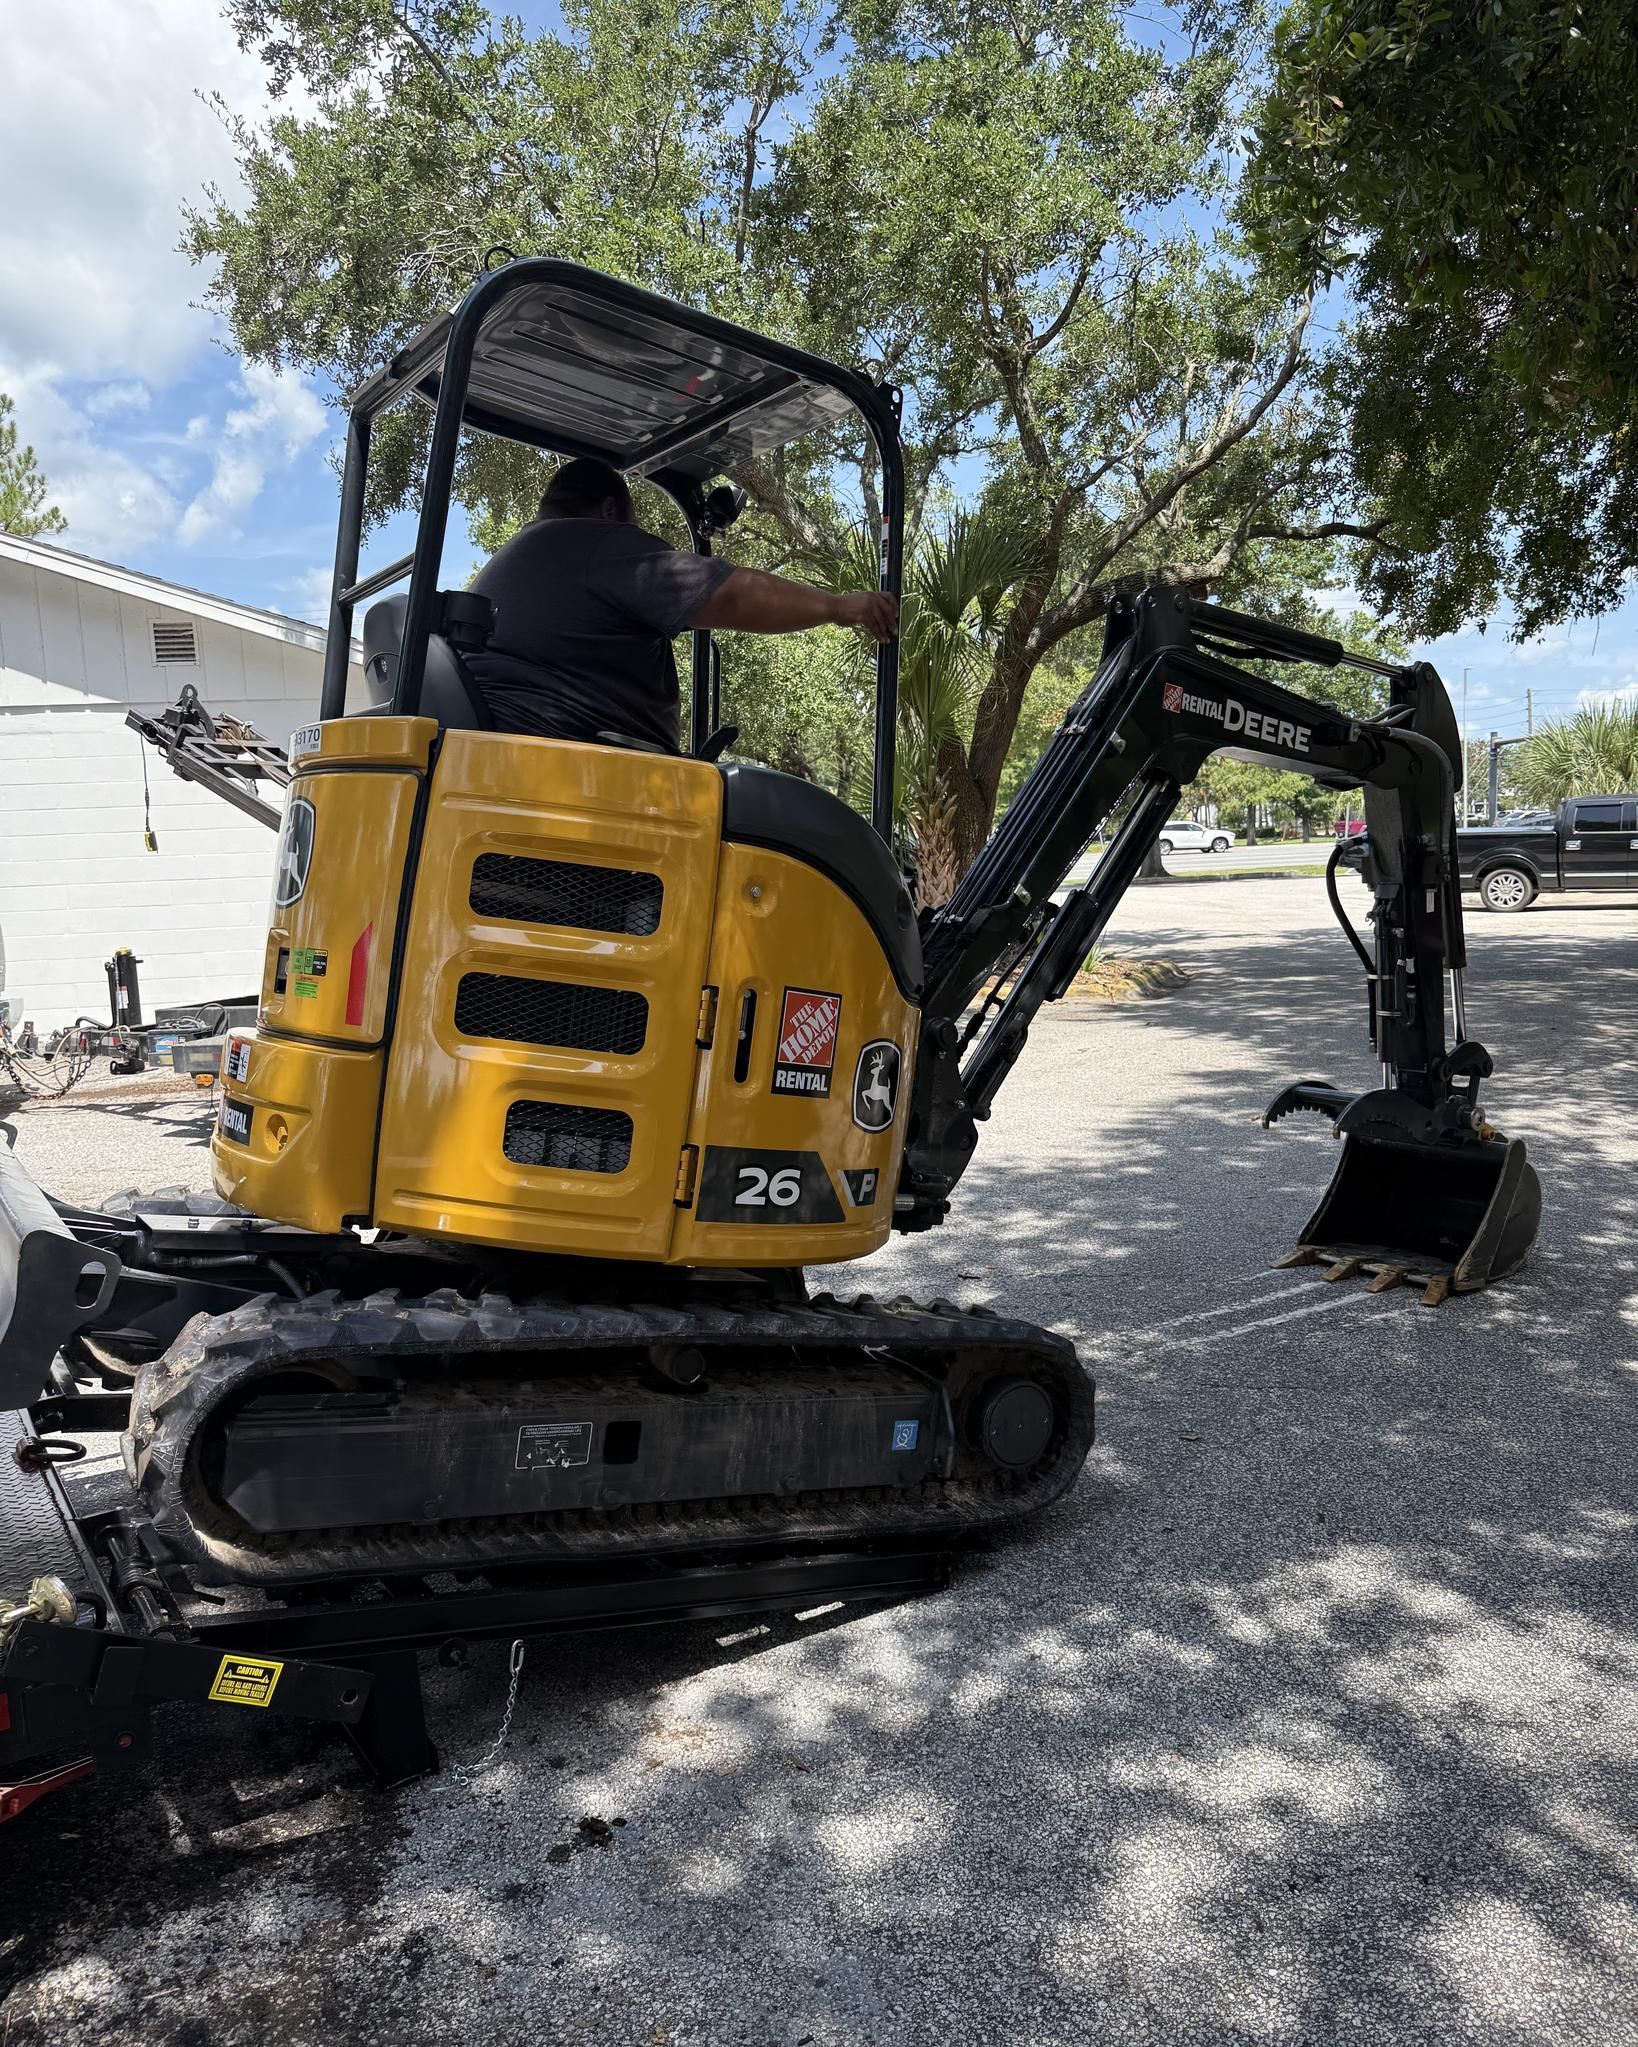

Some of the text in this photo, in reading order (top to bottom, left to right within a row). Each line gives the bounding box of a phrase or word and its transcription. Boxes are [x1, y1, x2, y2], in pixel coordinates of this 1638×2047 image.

[1181, 692, 1224, 721] RENTAL
[294, 728, 320, 747] 3170
[1223, 698, 1312, 753] DEERE
[789, 1001, 815, 1028] THE
[780, 998, 838, 1062] HOME
[801, 1023, 835, 1064] DEPOT
[775, 1069, 828, 1092] RENTAL
[735, 1167, 800, 1206] 26
[236, 1666, 263, 1676] CAUTION
